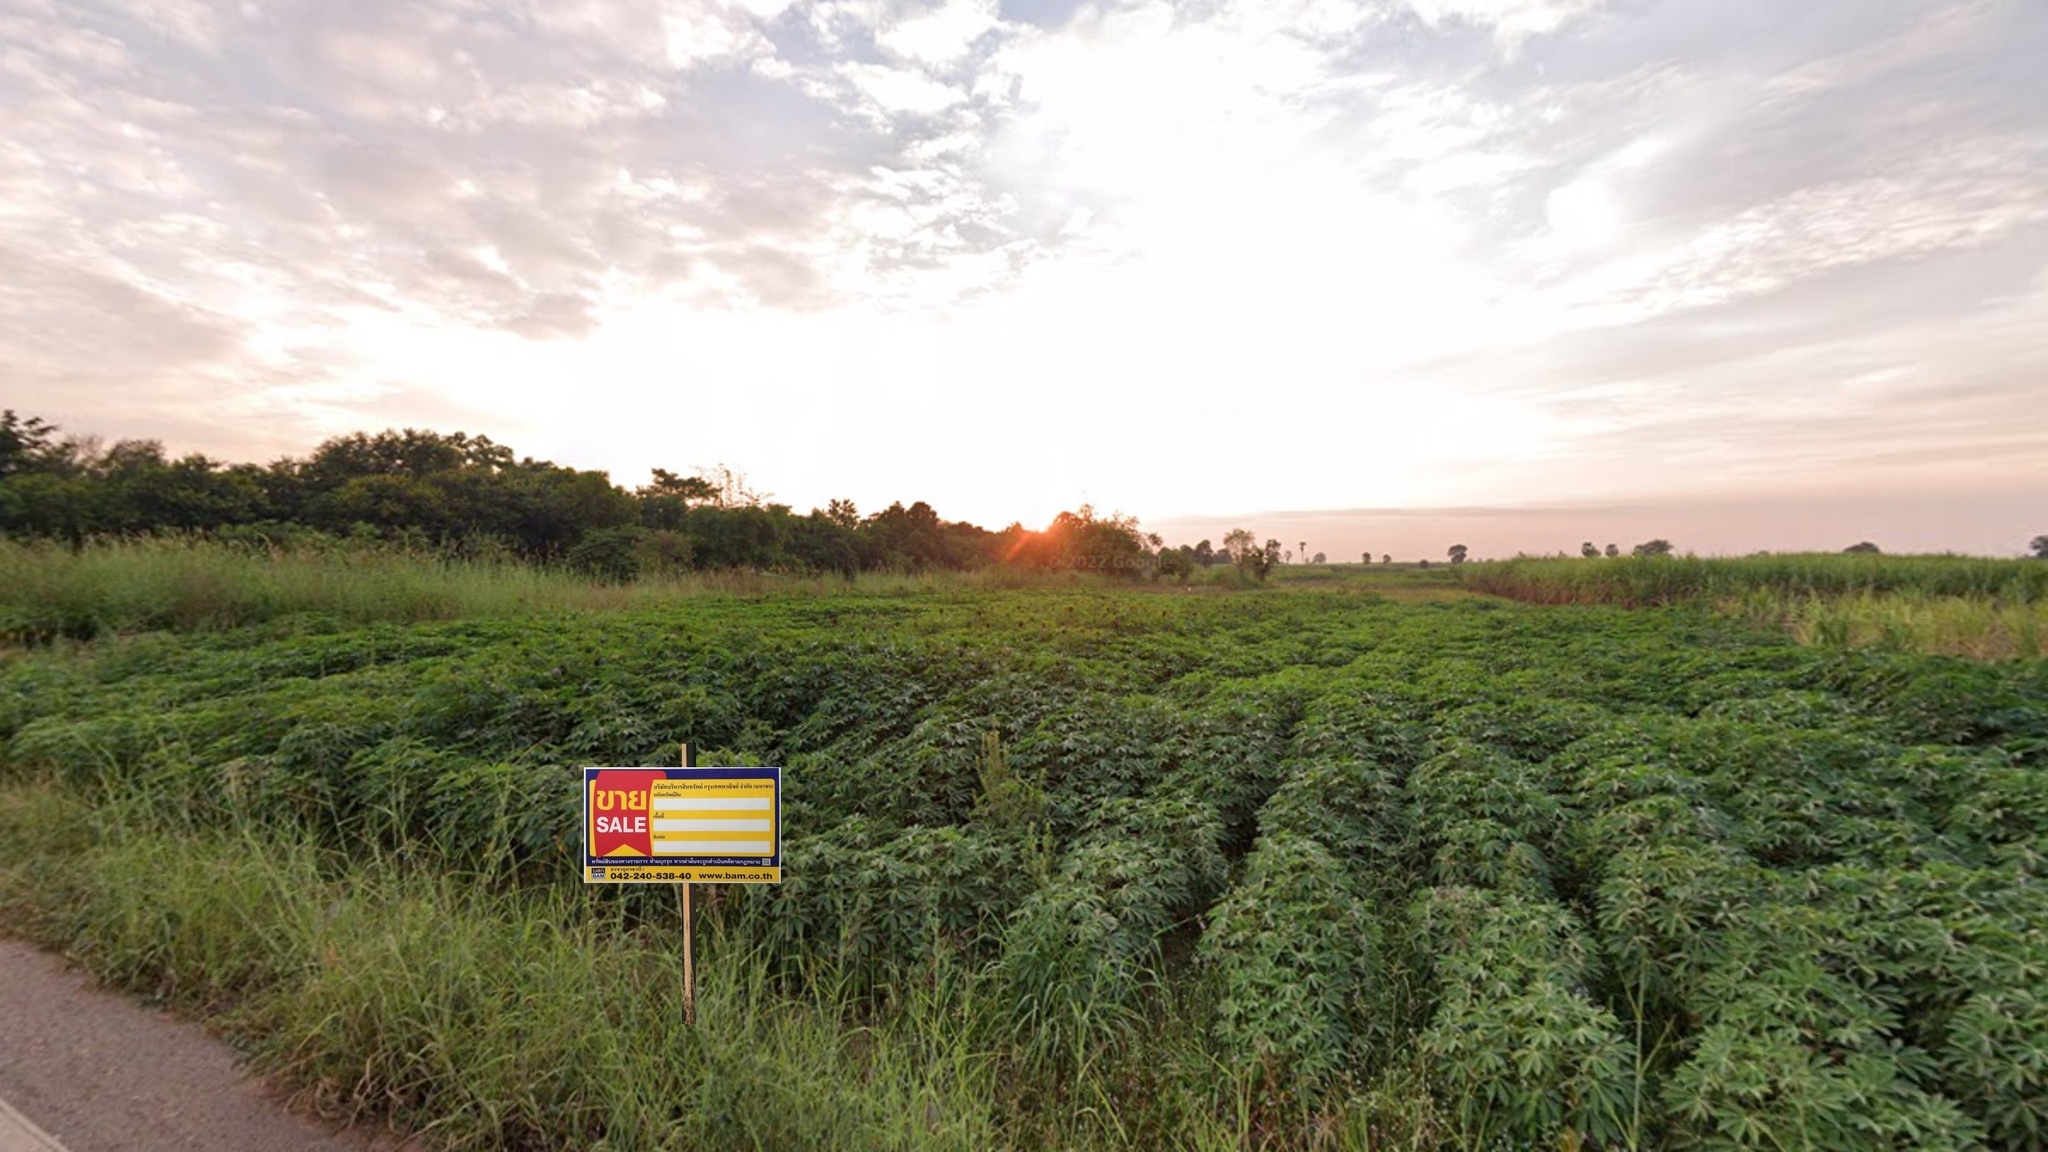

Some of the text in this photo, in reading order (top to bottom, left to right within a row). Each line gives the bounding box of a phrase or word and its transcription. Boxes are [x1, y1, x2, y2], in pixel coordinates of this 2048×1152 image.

[596, 790, 647, 811] ขาย
[596, 816, 647, 833] SALE
[610, 872, 773, 880] 042-240-538-40 www.bam.co.th
